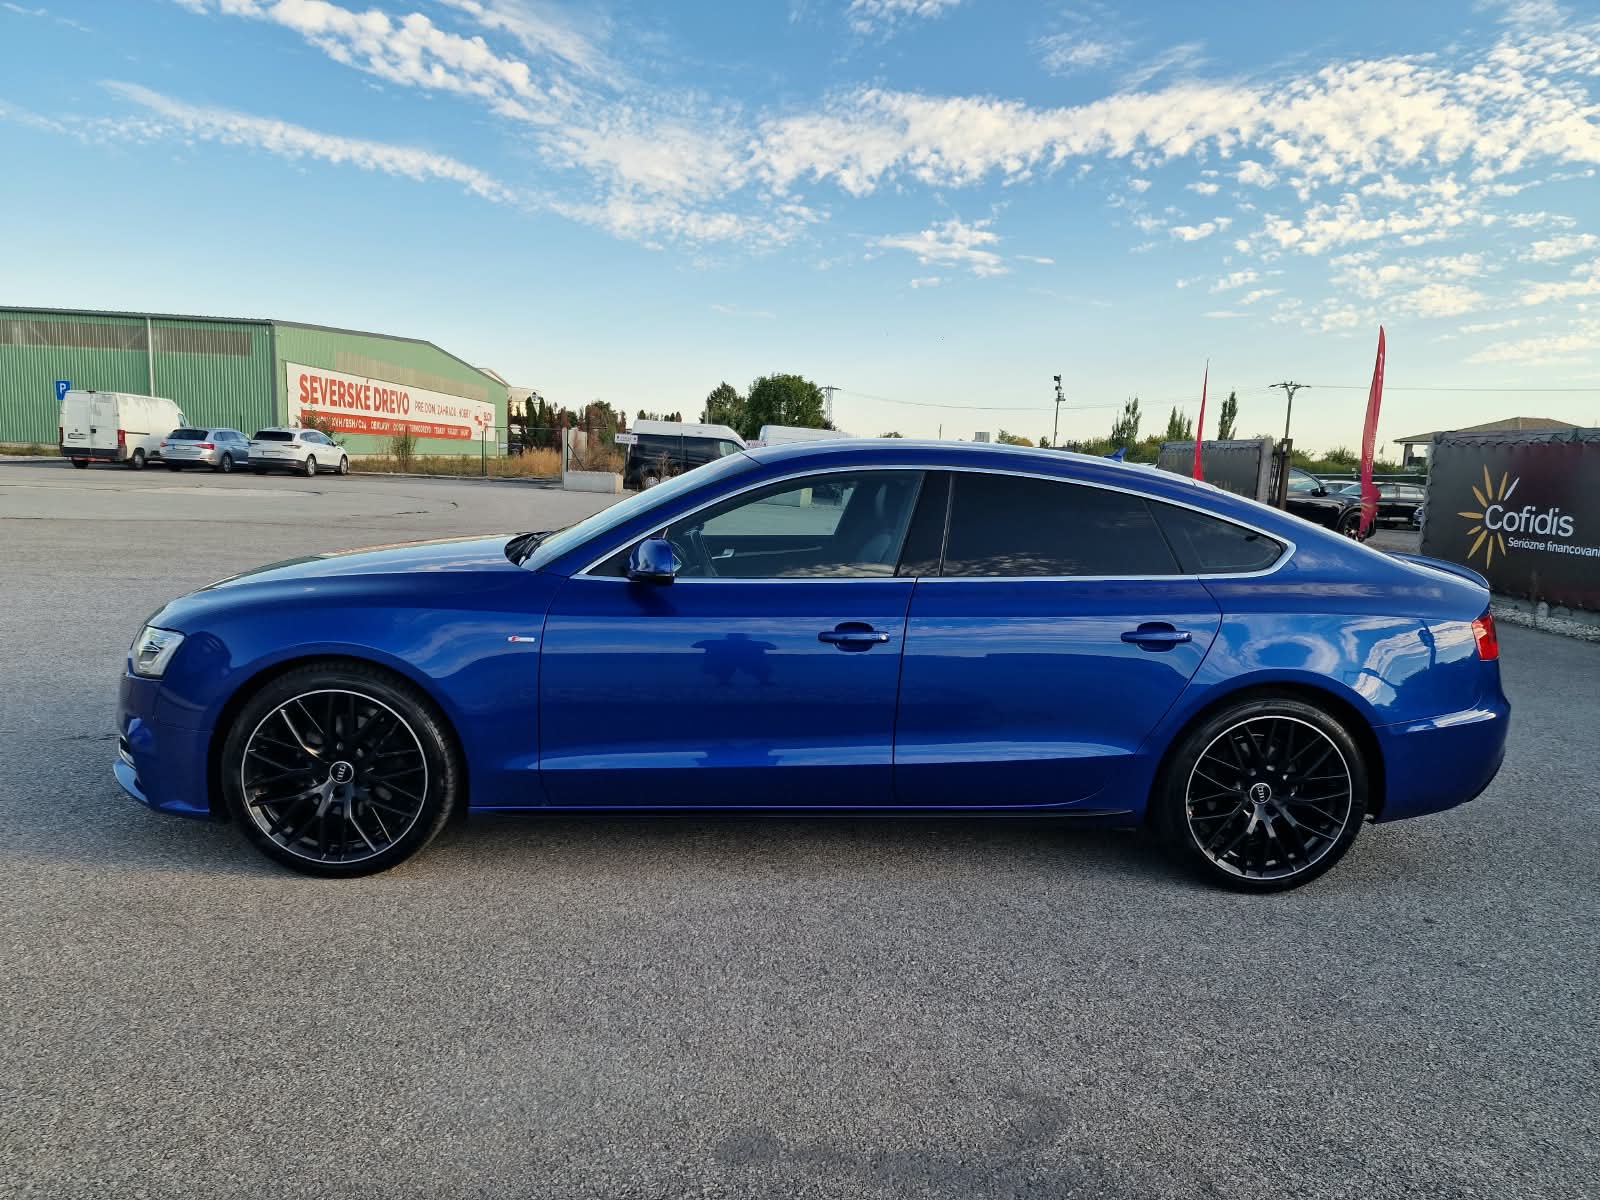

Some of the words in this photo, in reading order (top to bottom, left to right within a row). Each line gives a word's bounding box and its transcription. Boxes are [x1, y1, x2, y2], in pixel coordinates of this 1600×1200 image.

[60, 383, 66, 394] P
[300, 374, 371, 411] SEVERSKÉ
[374, 387, 410, 415] DREVO
[1485, 504, 1575, 537] Cofidis
